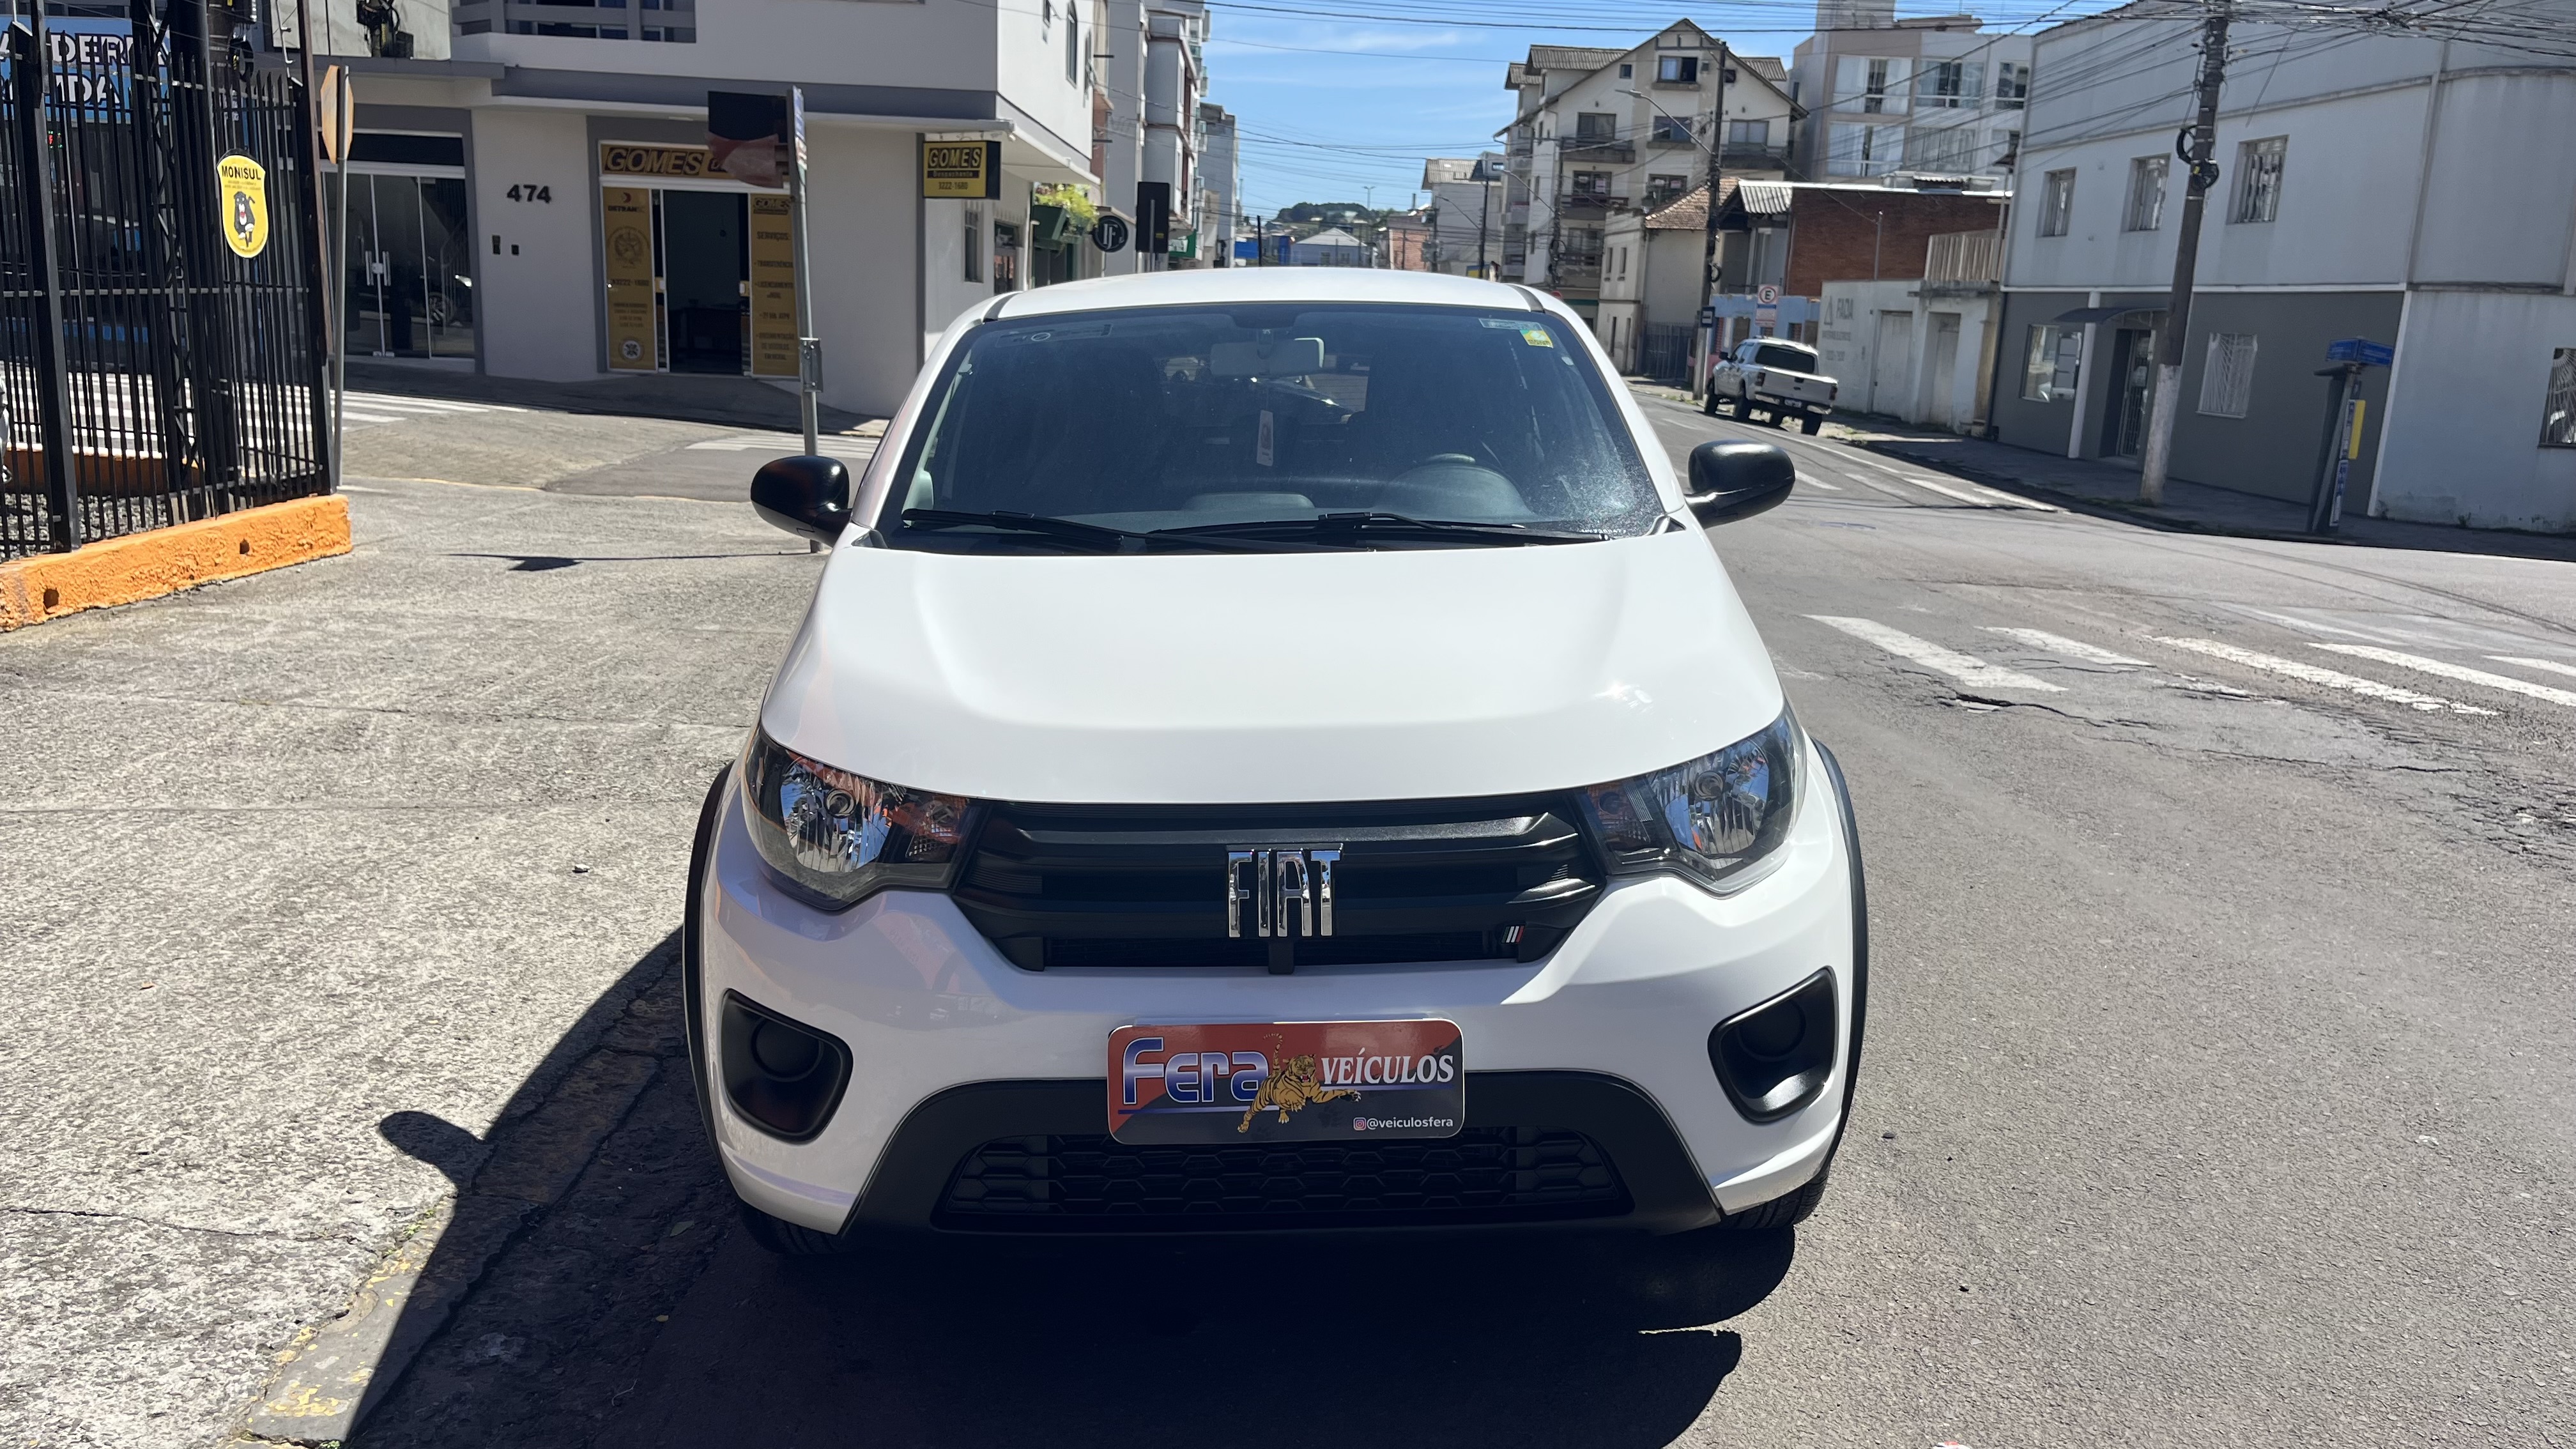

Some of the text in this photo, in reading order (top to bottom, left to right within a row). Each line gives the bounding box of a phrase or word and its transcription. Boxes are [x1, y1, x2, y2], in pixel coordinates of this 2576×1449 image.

[607, 147, 703, 176] GOMES
[929, 148, 981, 167] GOMES
[222, 165, 261, 180] MONISUL
[507, 183, 551, 204] 474
[1765, 290, 1772, 300] E
[1229, 850, 1340, 937] FIAT
[1321, 1047, 1454, 1085] VEÍCULOS
[1367, 1116, 1453, 1130] @veiculosfera
